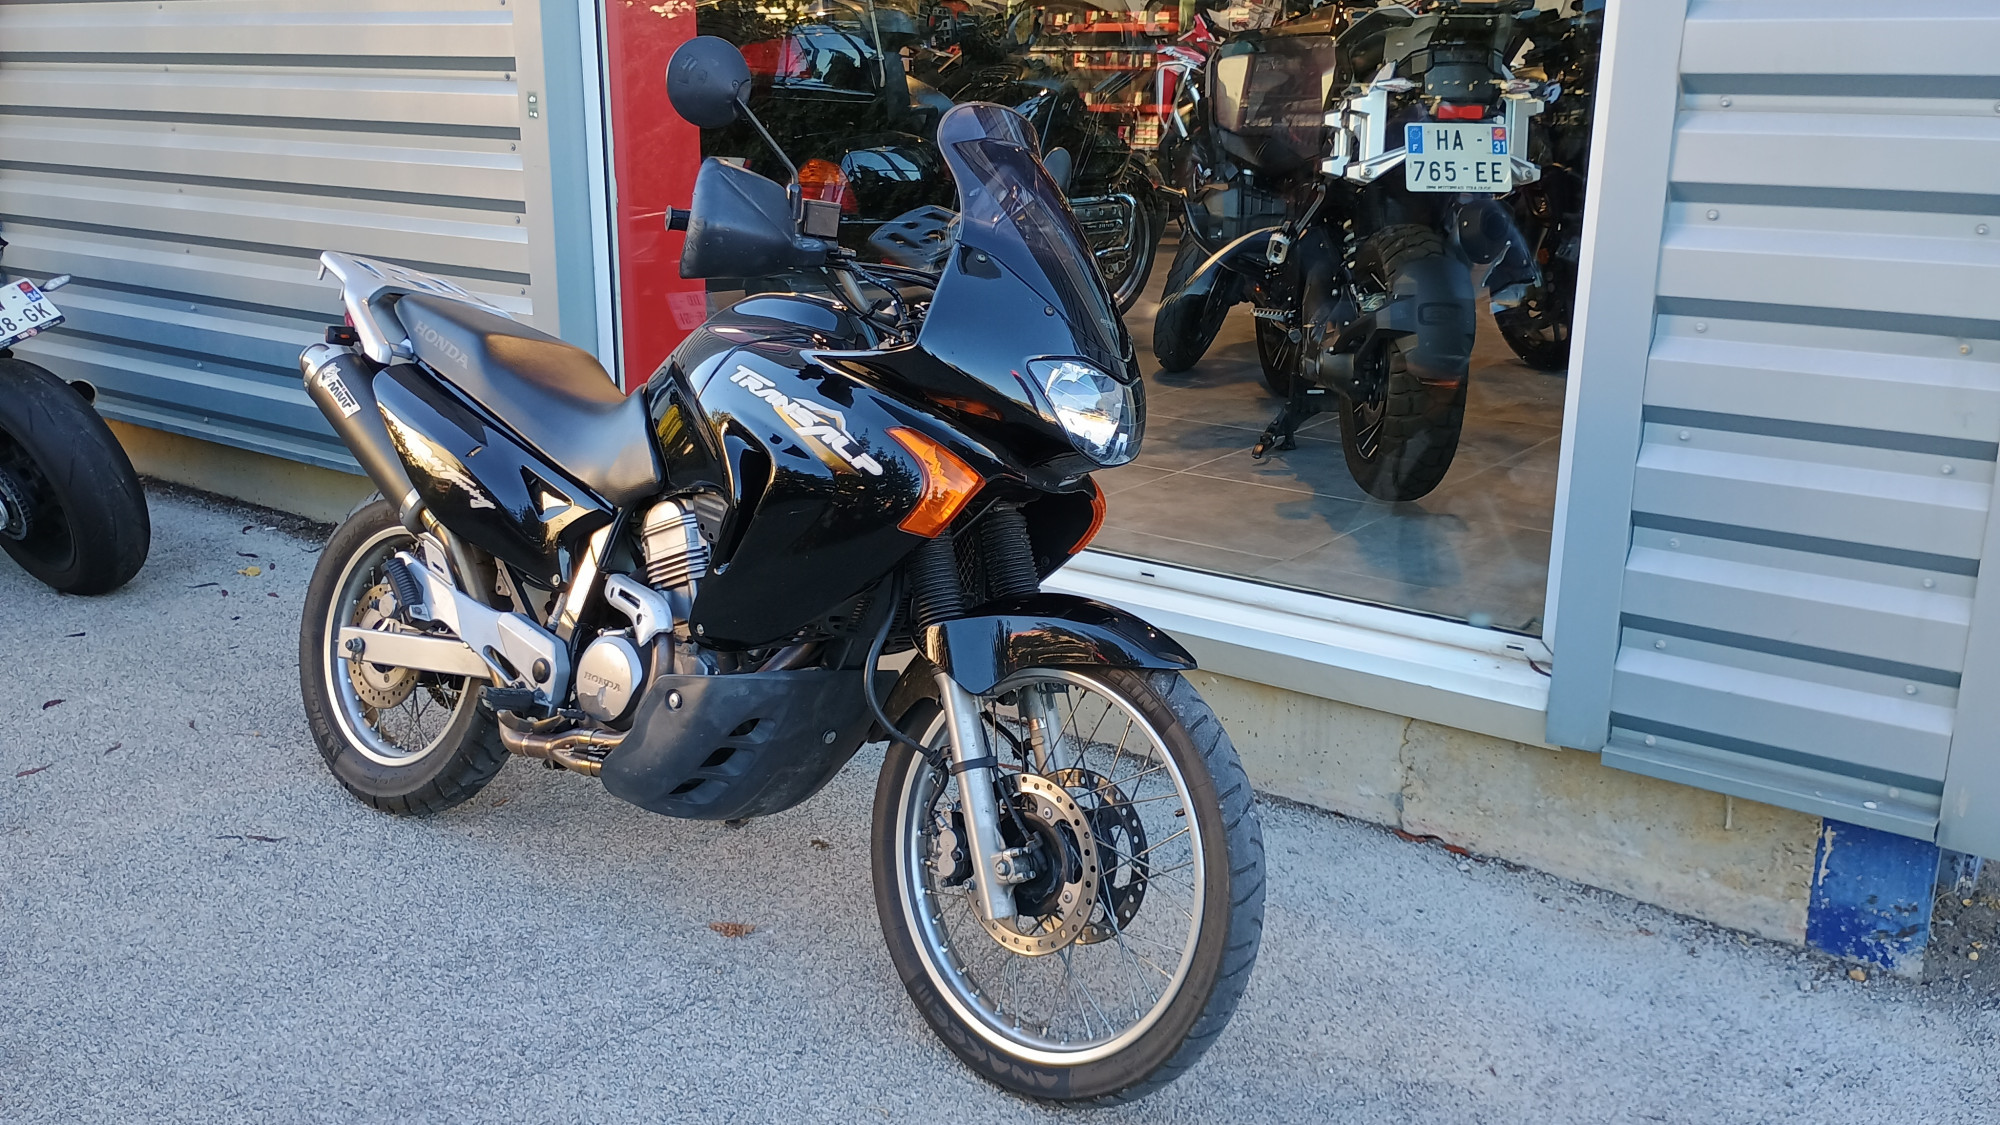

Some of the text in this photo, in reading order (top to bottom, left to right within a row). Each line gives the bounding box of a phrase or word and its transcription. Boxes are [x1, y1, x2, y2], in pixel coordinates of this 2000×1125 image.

[1412, 143, 1419, 152] F
[1436, 129, 1464, 151] HA
[1493, 140, 1506, 153] 31
[1413, 160, 1503, 183] 765-EE
[414, 320, 469, 370] HONDA
[730, 365, 883, 476] TRANSALP
[584, 671, 622, 692] HONDA
